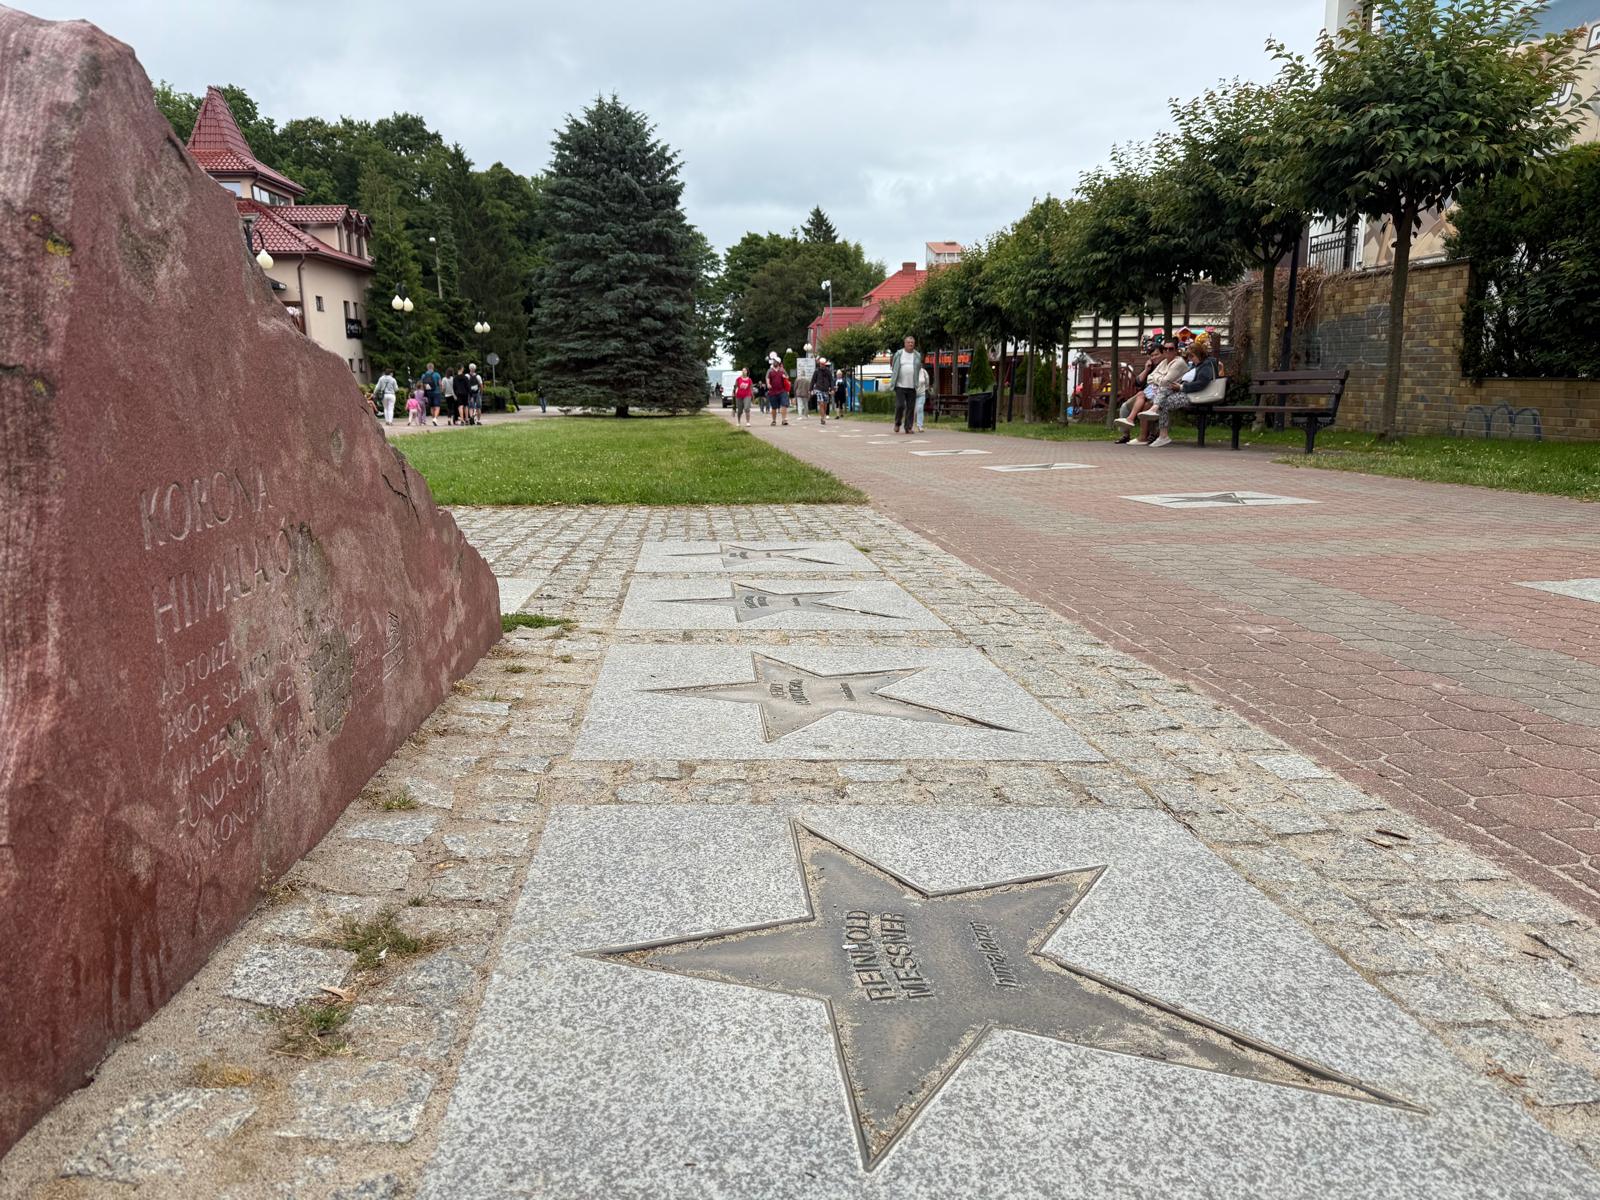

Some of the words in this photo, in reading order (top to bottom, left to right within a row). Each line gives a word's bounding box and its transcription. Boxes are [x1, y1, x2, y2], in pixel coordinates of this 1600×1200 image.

[138, 466, 275, 550] KORONA
[846, 910, 897, 1001] REINHOLD
[880, 912, 934, 999] MESSNER
